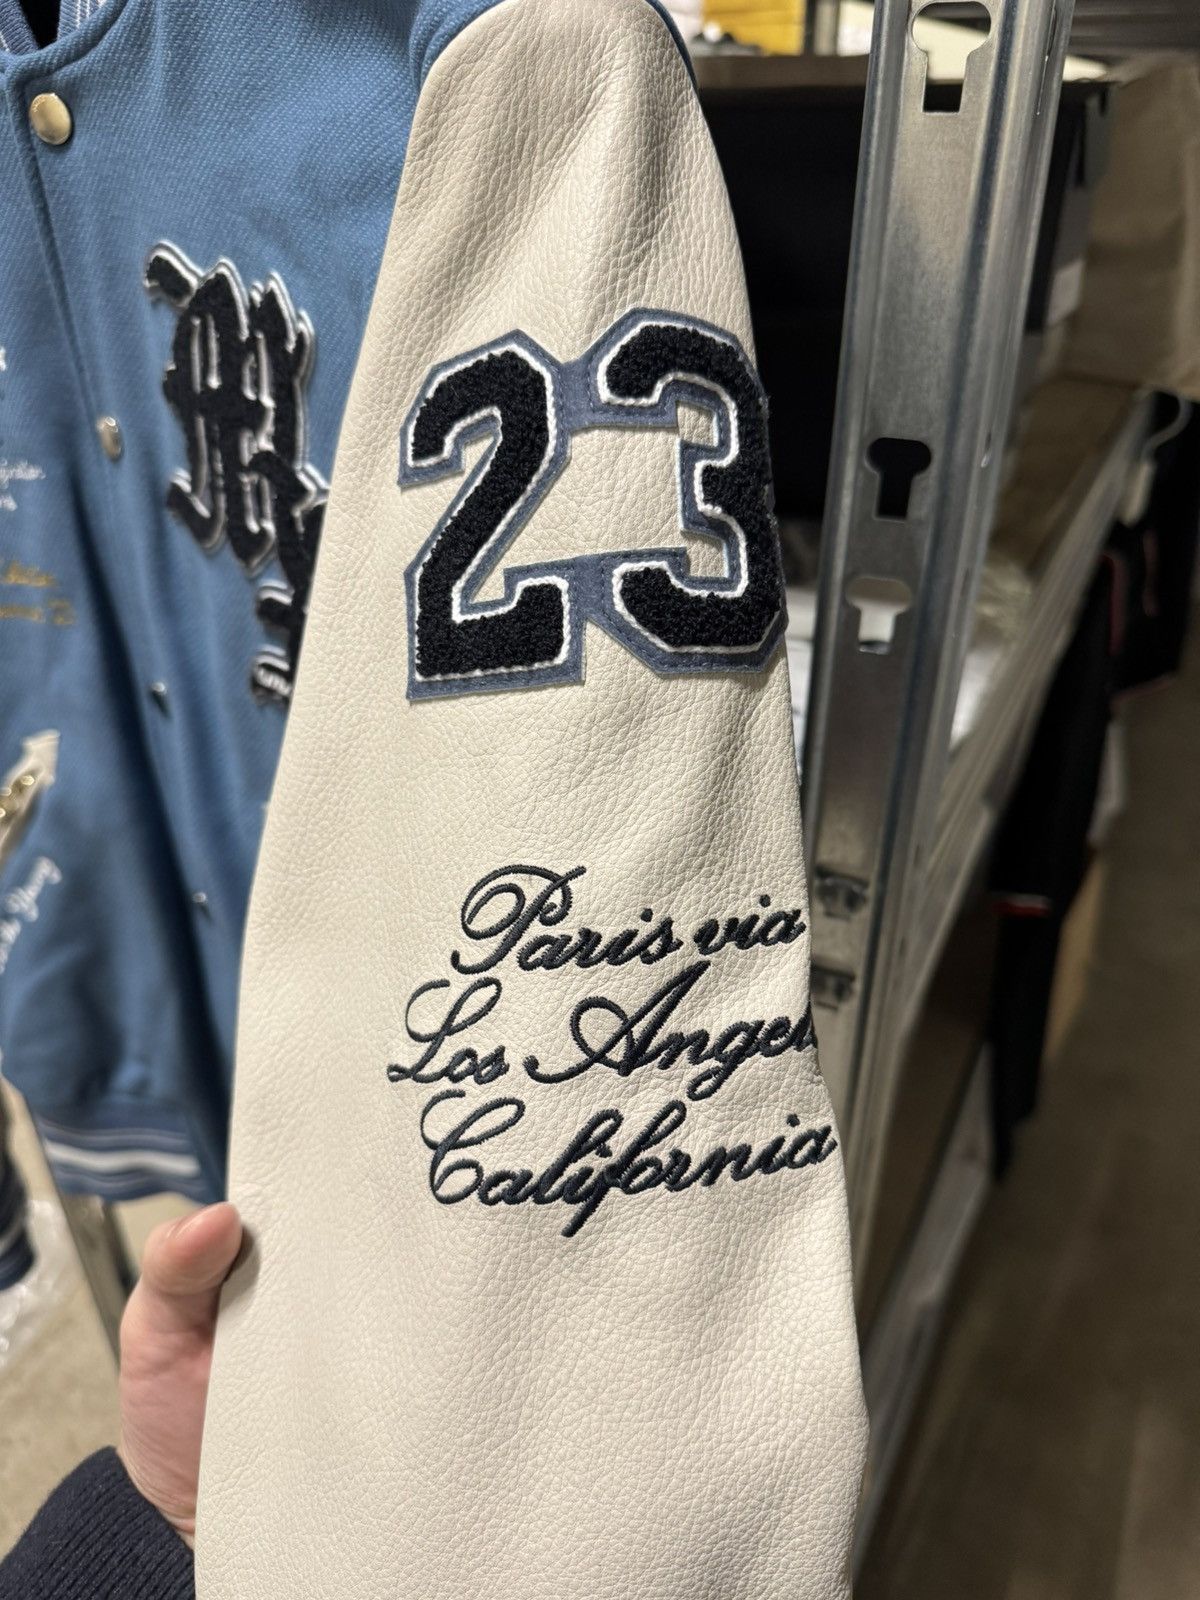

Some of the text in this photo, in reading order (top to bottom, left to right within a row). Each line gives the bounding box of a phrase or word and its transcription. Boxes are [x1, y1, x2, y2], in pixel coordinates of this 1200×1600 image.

[405, 316, 787, 687] 23
[451, 864, 807, 974] Paris via
[386, 977, 509, 1084] Los
[420, 1089, 839, 1238] California
